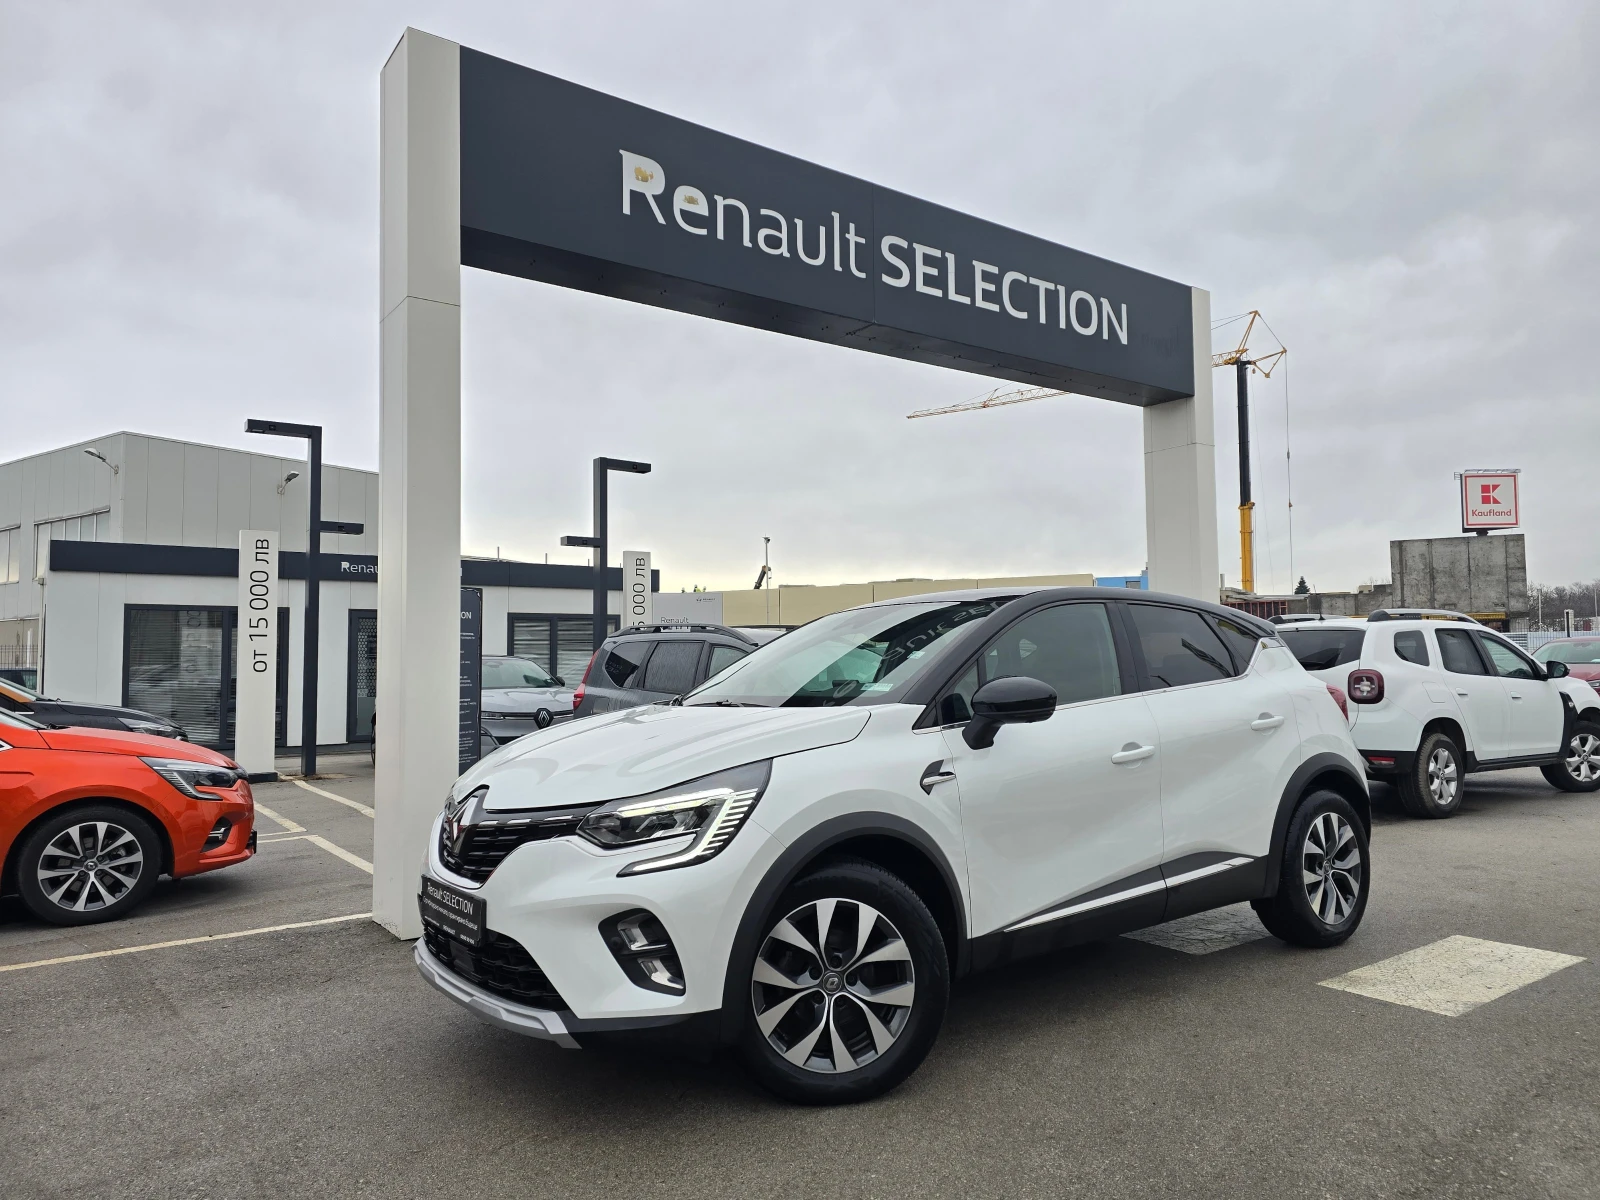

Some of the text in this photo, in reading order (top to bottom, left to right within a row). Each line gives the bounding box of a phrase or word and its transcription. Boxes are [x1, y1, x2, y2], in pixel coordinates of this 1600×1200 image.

[619, 149, 1128, 345] Renault SELECTION
[1471, 508, 1512, 517] Kaufland
[249, 570, 269, 611] 000
[632, 582, 646, 616] 000
[248, 617, 269, 642] 15
[442, 890, 474, 916] SELECTION
